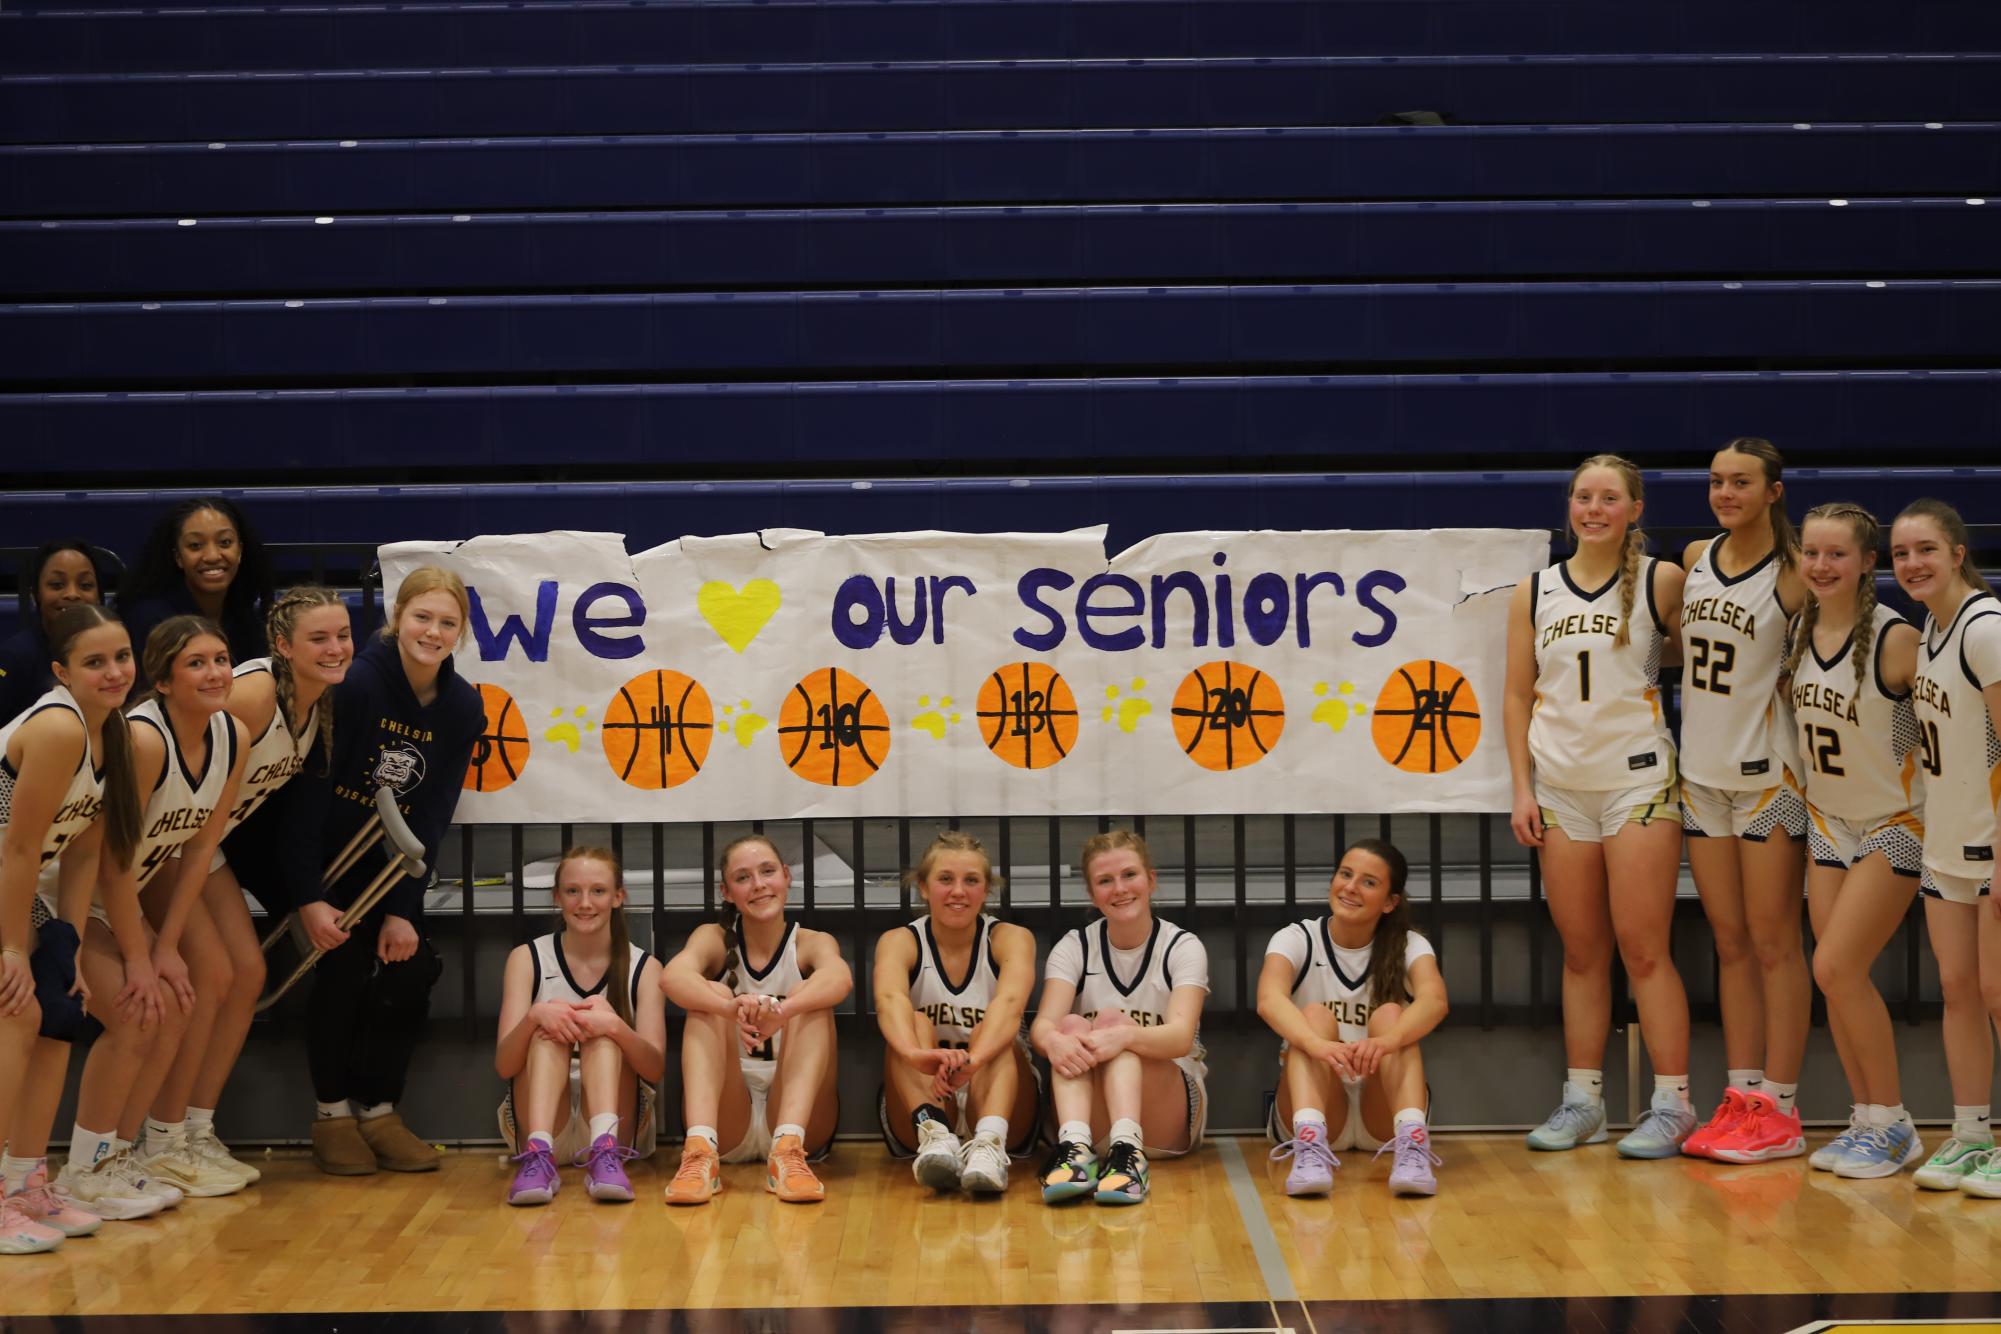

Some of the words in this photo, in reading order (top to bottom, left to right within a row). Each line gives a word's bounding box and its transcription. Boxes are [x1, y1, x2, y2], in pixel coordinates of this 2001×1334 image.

[832, 573, 977, 649] our
[1013, 551, 1406, 652] seniors
[1680, 597, 1756, 641] CHELSEA
[1542, 613, 1619, 650] CHELSE
[1576, 650, 1591, 702] 1
[1689, 636, 1736, 695] 22
[1914, 675, 1952, 719] ELSEA
[650, 704, 672, 755] 4
[817, 702, 860, 751] 10
[1010, 690, 1046, 736] 13
[1208, 687, 1247, 730] 20
[1415, 689, 1449, 731] 24
[246, 755, 304, 785] CHELS
[1803, 722, 1846, 777] 12
[335, 784, 413, 816] BASKEL
[146, 807, 214, 838] CHELS
[916, 1002, 986, 1029] HELSE
